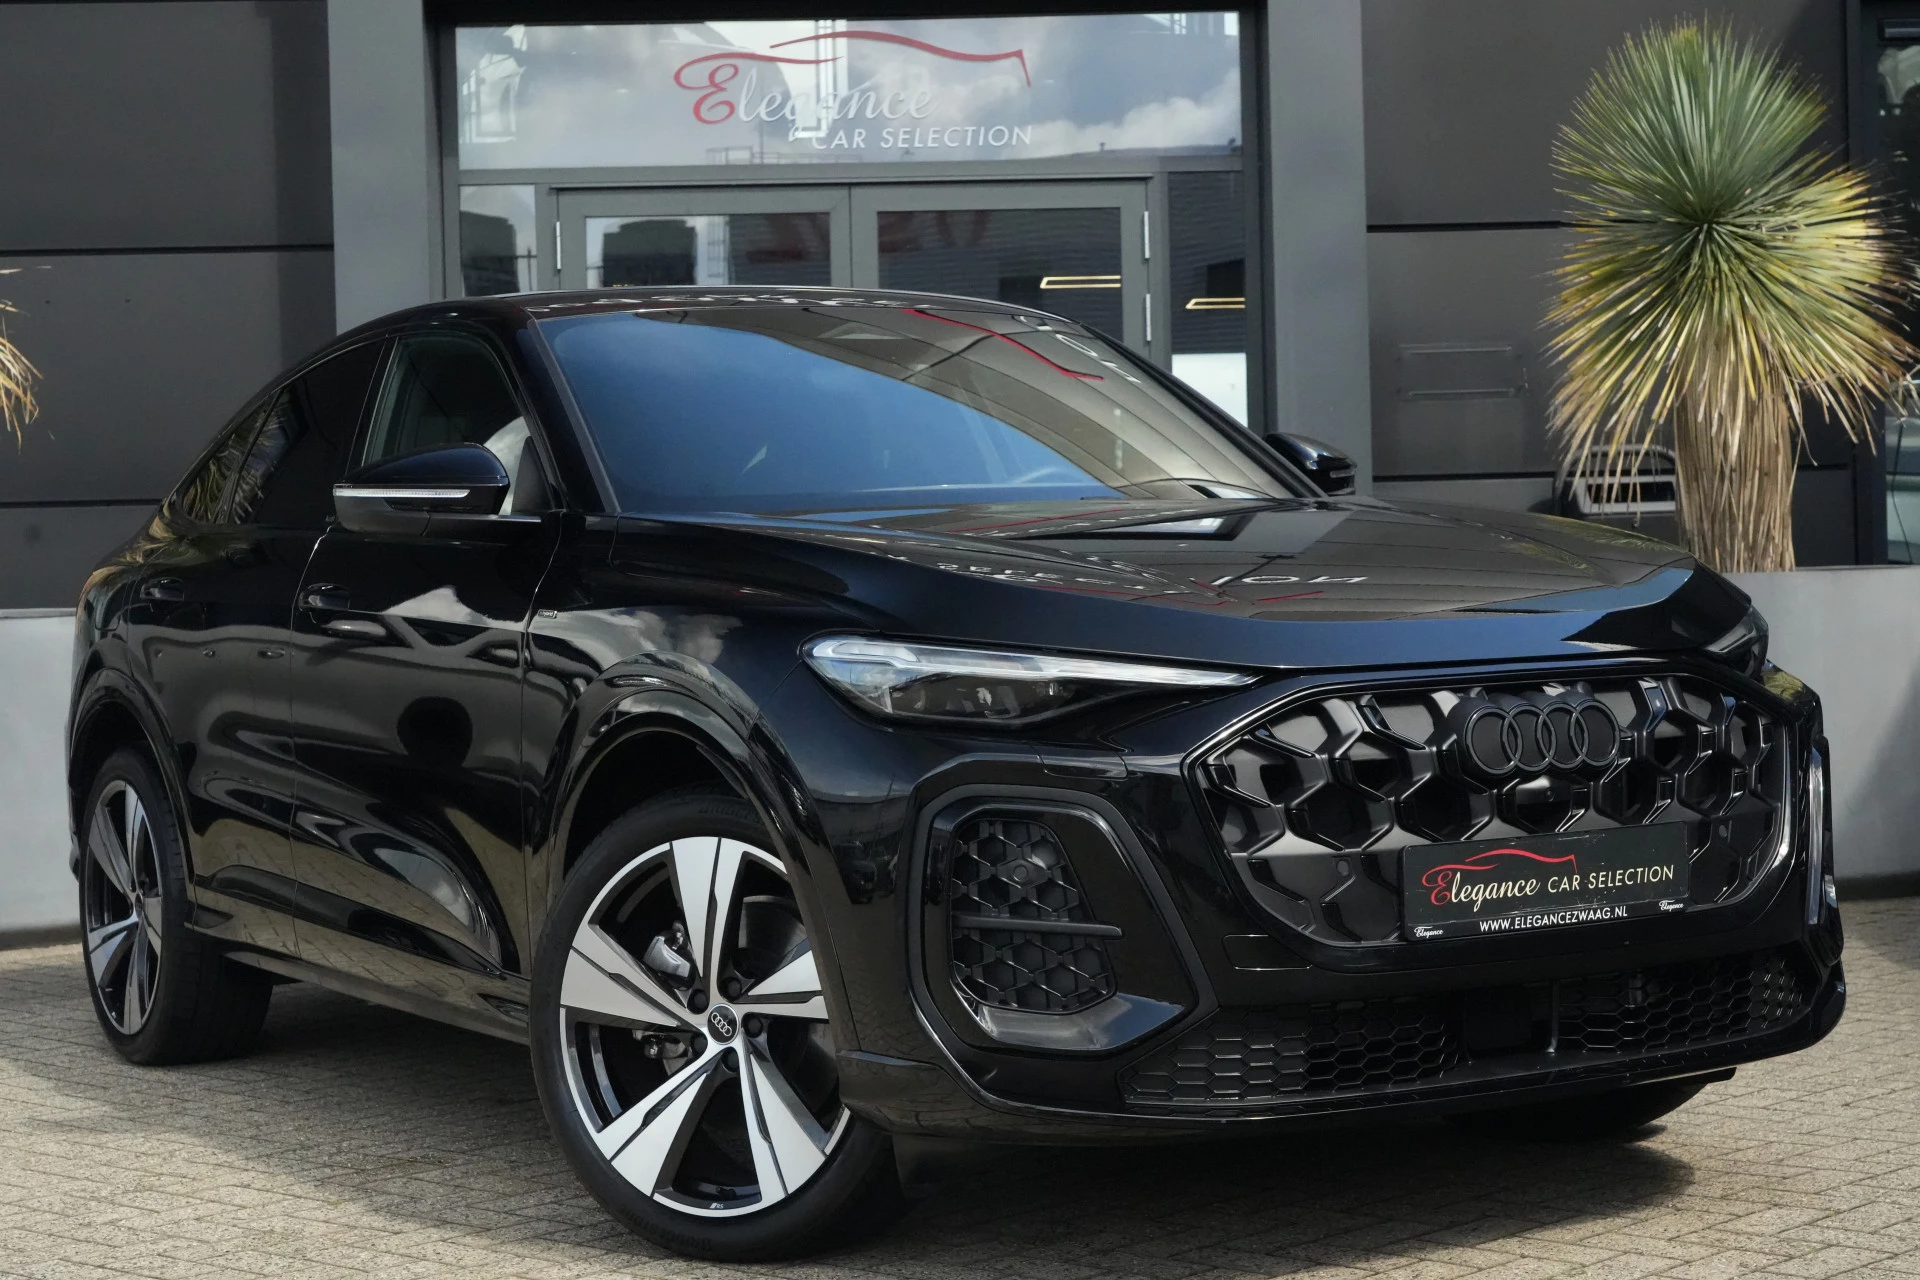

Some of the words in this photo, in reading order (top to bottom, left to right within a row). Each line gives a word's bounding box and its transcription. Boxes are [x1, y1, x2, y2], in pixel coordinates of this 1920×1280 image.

[673, 51, 937, 142] Elegance
[811, 127, 867, 150] CAR
[879, 125, 1032, 149] SELECTION
[1421, 863, 1541, 912] Elegance
[1547, 873, 1581, 894] CAR
[1587, 863, 1675, 890] SELECTION
[1658, 899, 1684, 912] Elegance
[1413, 925, 1444, 939] Elegance
[1479, 905, 1629, 933] WWW.ELEGANCEZWAAG.NL
